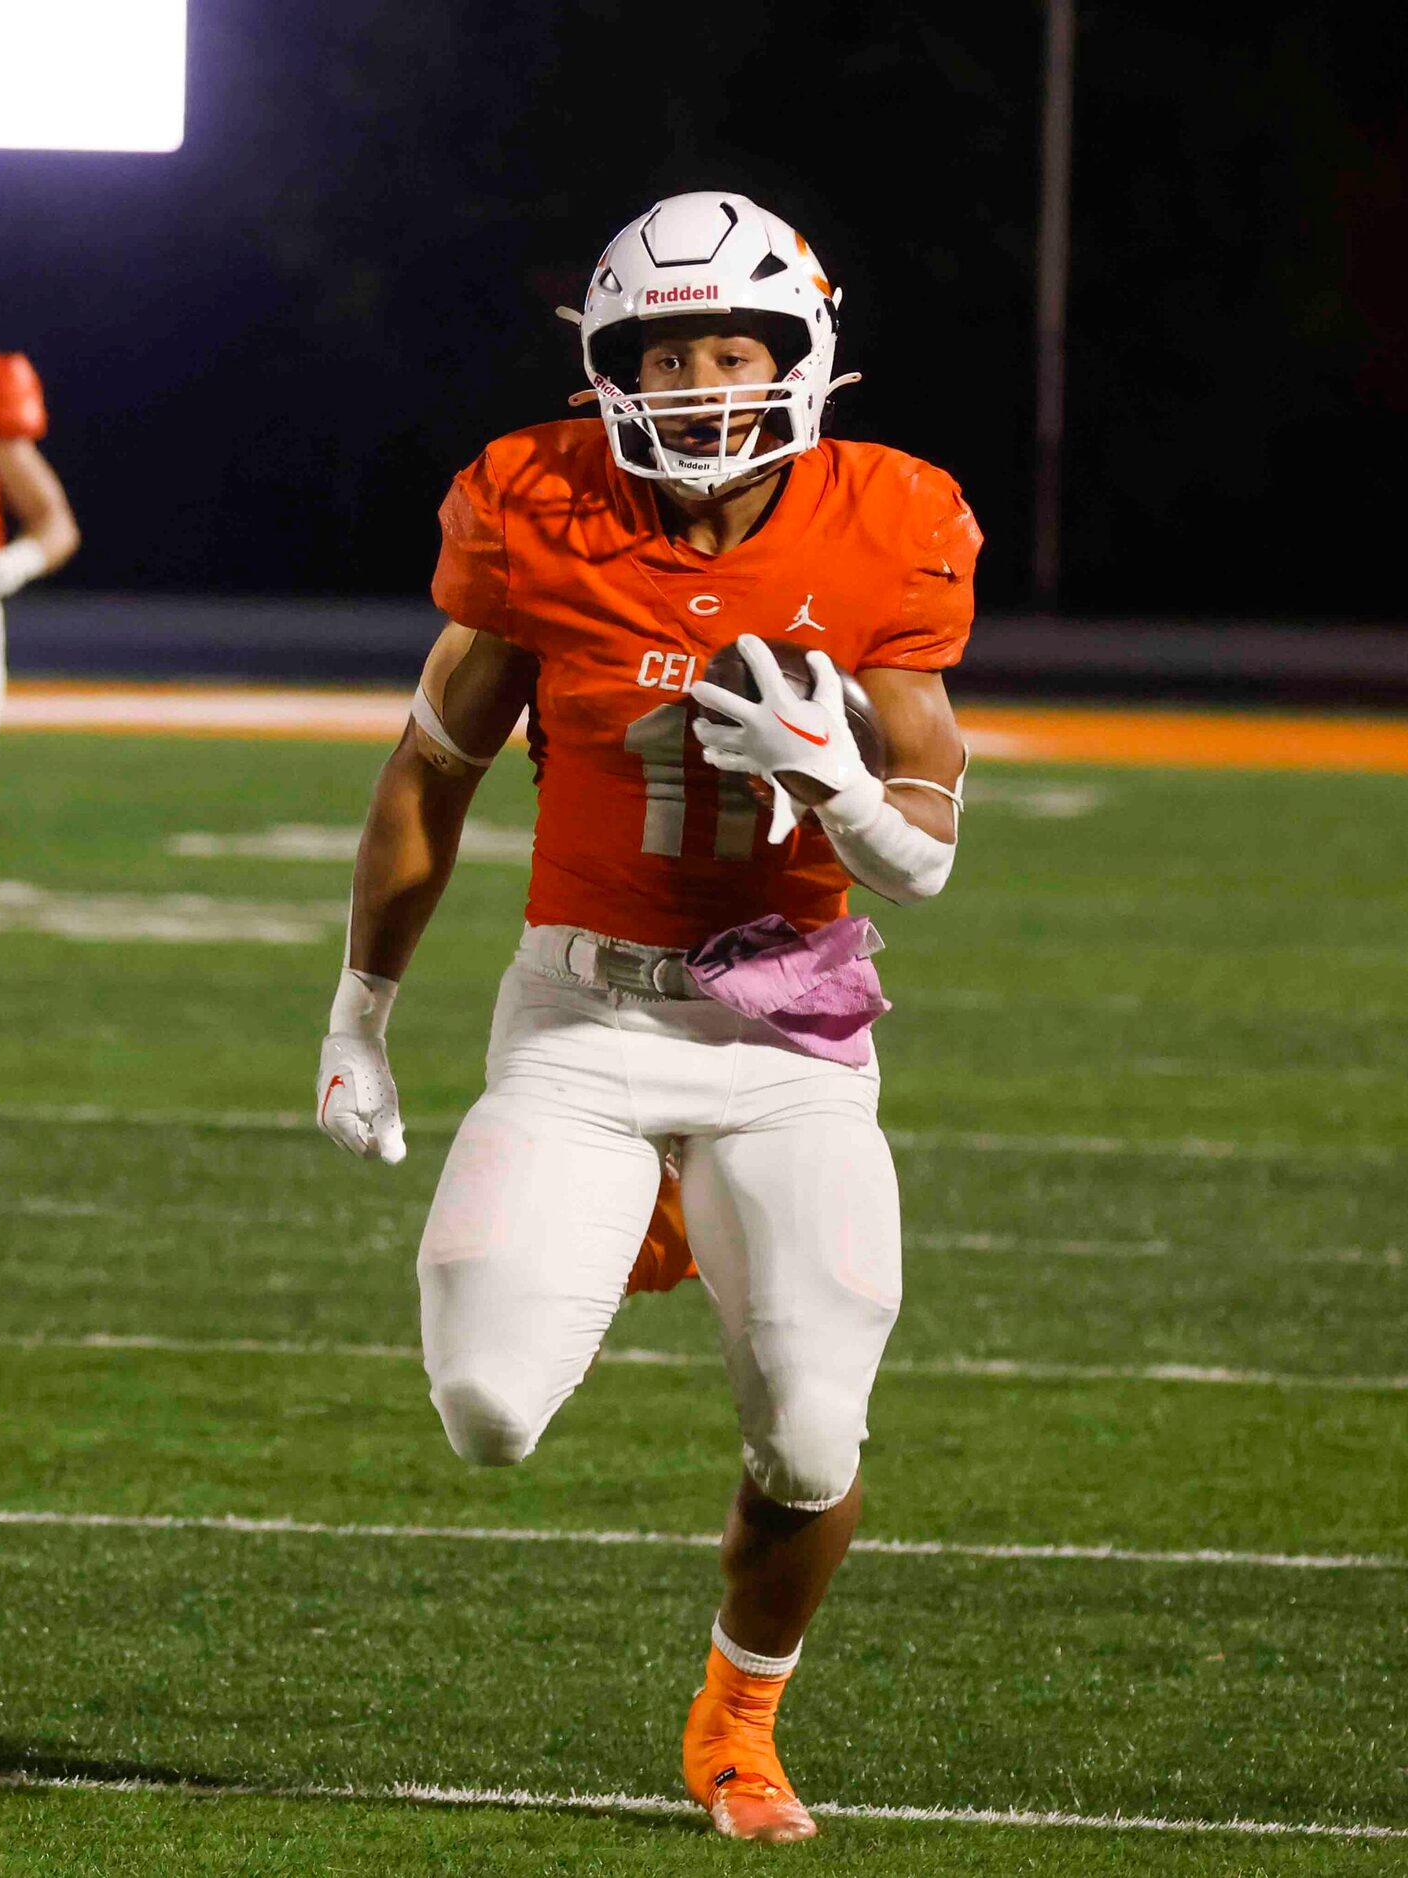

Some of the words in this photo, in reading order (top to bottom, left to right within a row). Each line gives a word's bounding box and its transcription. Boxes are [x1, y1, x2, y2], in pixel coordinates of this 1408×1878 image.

[645, 285, 719, 305] Riddell
[678, 459, 710, 471] Riddell
[636, 650, 696, 693] CEL
